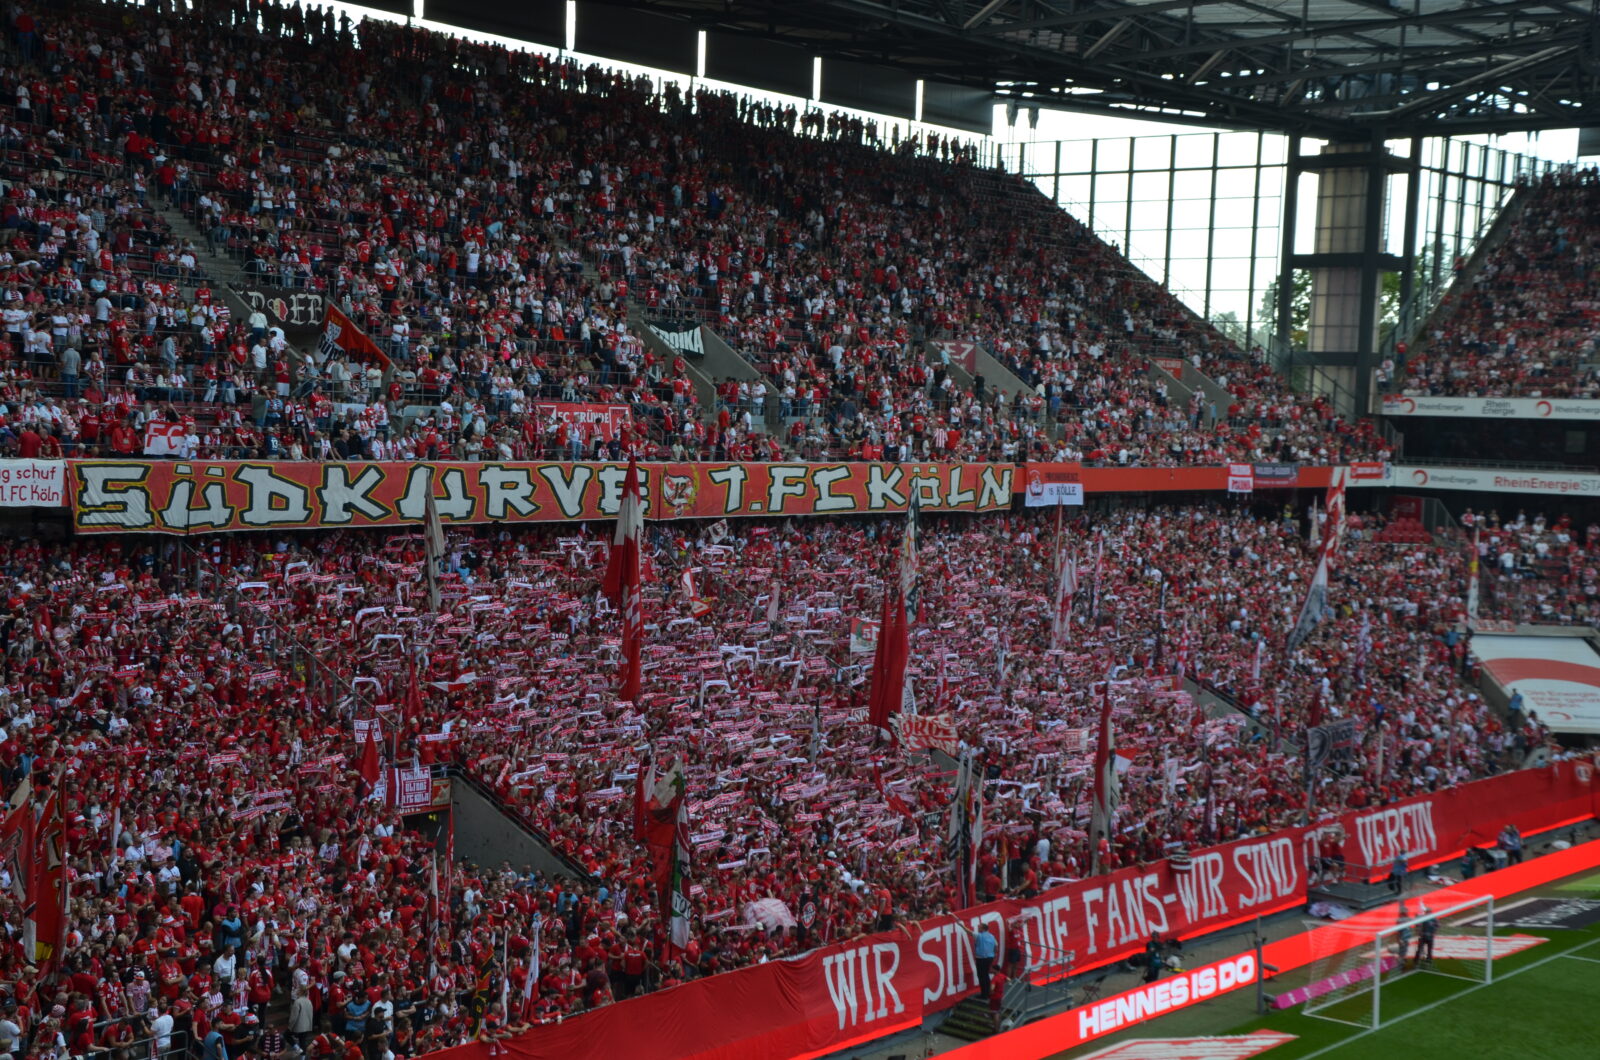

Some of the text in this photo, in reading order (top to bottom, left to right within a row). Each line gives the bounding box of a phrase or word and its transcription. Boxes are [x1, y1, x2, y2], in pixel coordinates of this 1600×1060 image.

[1481, 407, 1516, 417] Energie
[1486, 400, 1511, 408] Rhein
[147, 423, 183, 449] FC
[16, 462, 57, 480] schuf
[31, 484, 59, 502] Köln
[75, 462, 651, 530] SÜDKURVE
[864, 463, 1014, 513] KÖLN
[822, 942, 905, 1030] WIR
[1021, 896, 1075, 972] DIE
[1233, 837, 1298, 909] SIND
[1355, 801, 1437, 868] VEREIN
[1079, 955, 1255, 1039] HENNES IS DO
